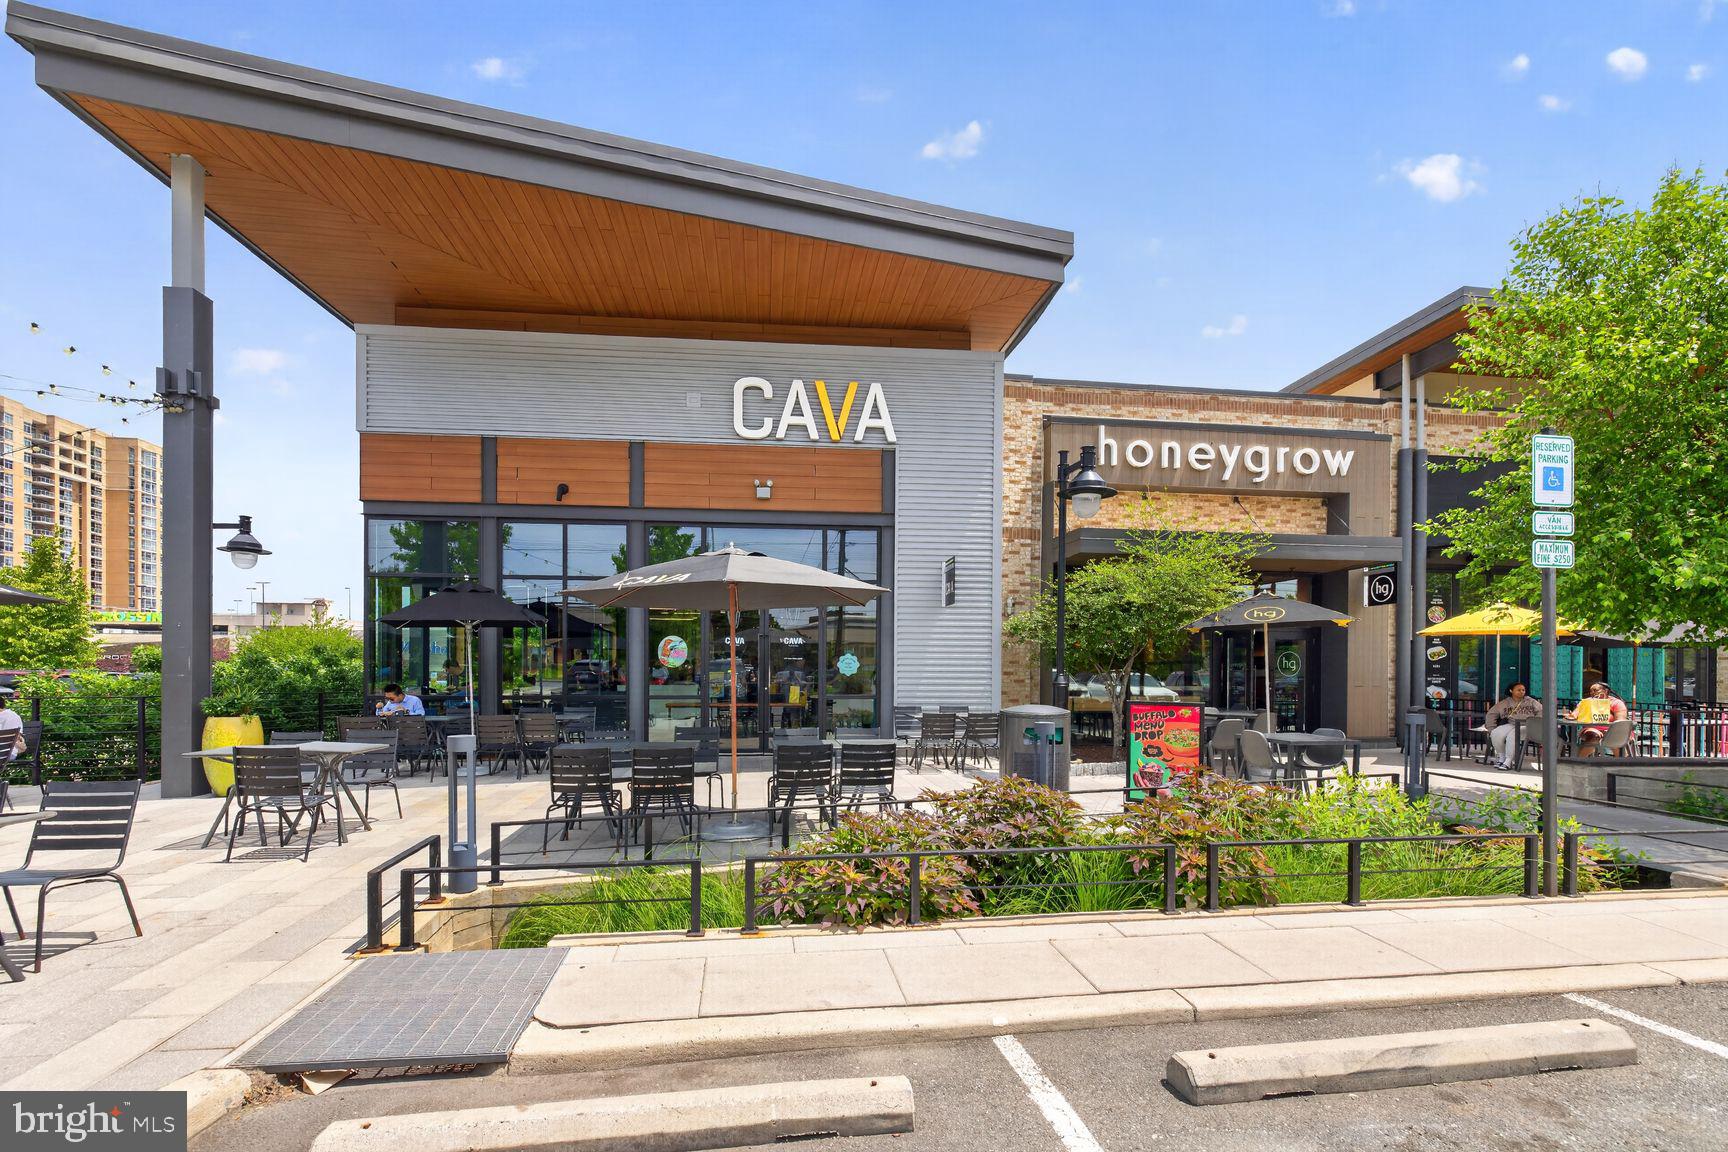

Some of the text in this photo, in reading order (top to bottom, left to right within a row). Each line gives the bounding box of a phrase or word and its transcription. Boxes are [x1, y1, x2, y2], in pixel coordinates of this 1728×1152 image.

[733, 376, 897, 443] CAVA
[1535, 442, 1571, 452] RESERVED
[1098, 424, 1355, 483] honeygrow
[1538, 454, 1569, 464] PARKING
[1539, 543, 1569, 553] MAXIMUM
[1537, 553, 1571, 564] FINE $250
[1375, 581, 1389, 597] hg
[1253, 610, 1276, 618] hg
[724, 637, 745, 645] CVA
[783, 637, 803, 645] CAVA
[1282, 656, 1297, 671] hg
[1132, 709, 1176, 722] BUFFALO
[1134, 730, 1164, 741] DROP
